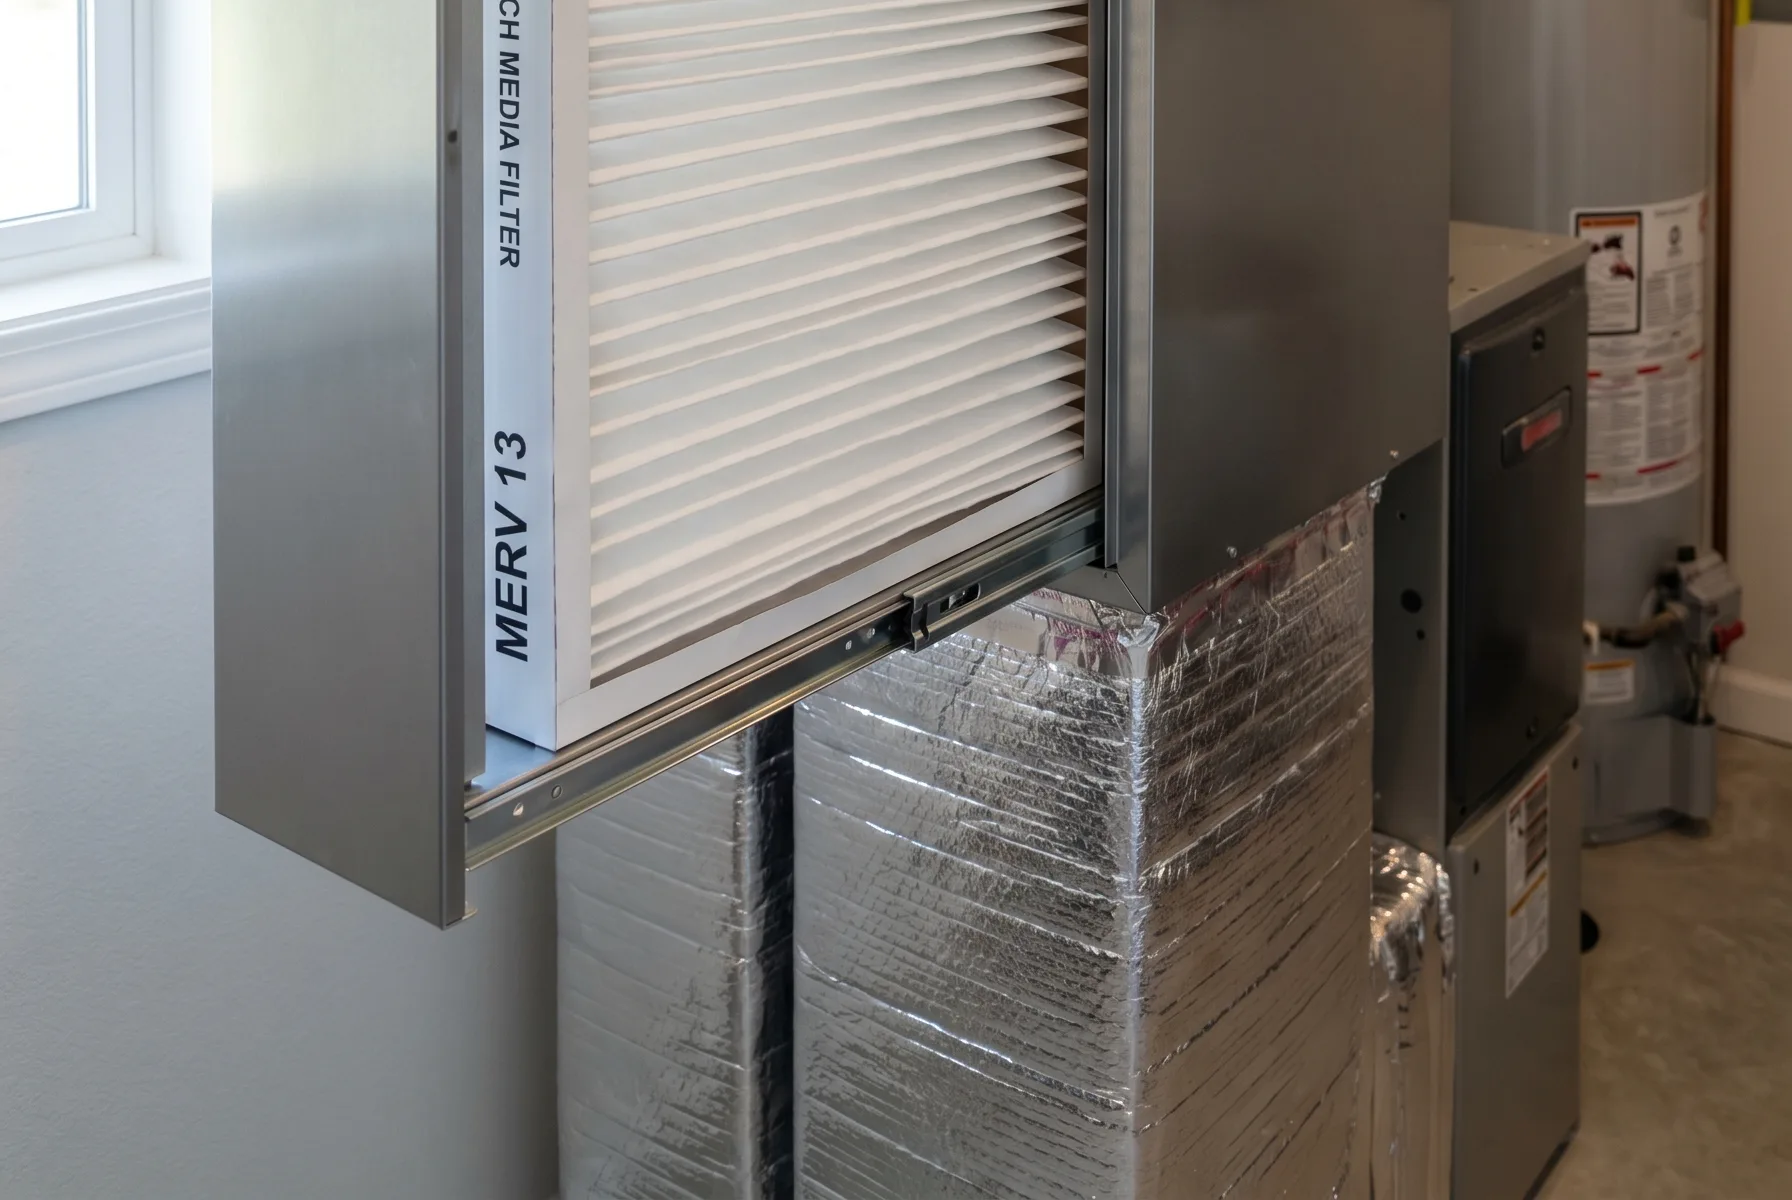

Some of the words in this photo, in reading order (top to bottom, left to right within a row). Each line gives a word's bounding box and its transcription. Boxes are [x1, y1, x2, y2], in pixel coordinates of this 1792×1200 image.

[500, 52, 519, 150] MEDIA
[500, 161, 519, 267] FILTER
[494, 431, 526, 485] 13
[495, 501, 527, 662] MERV
